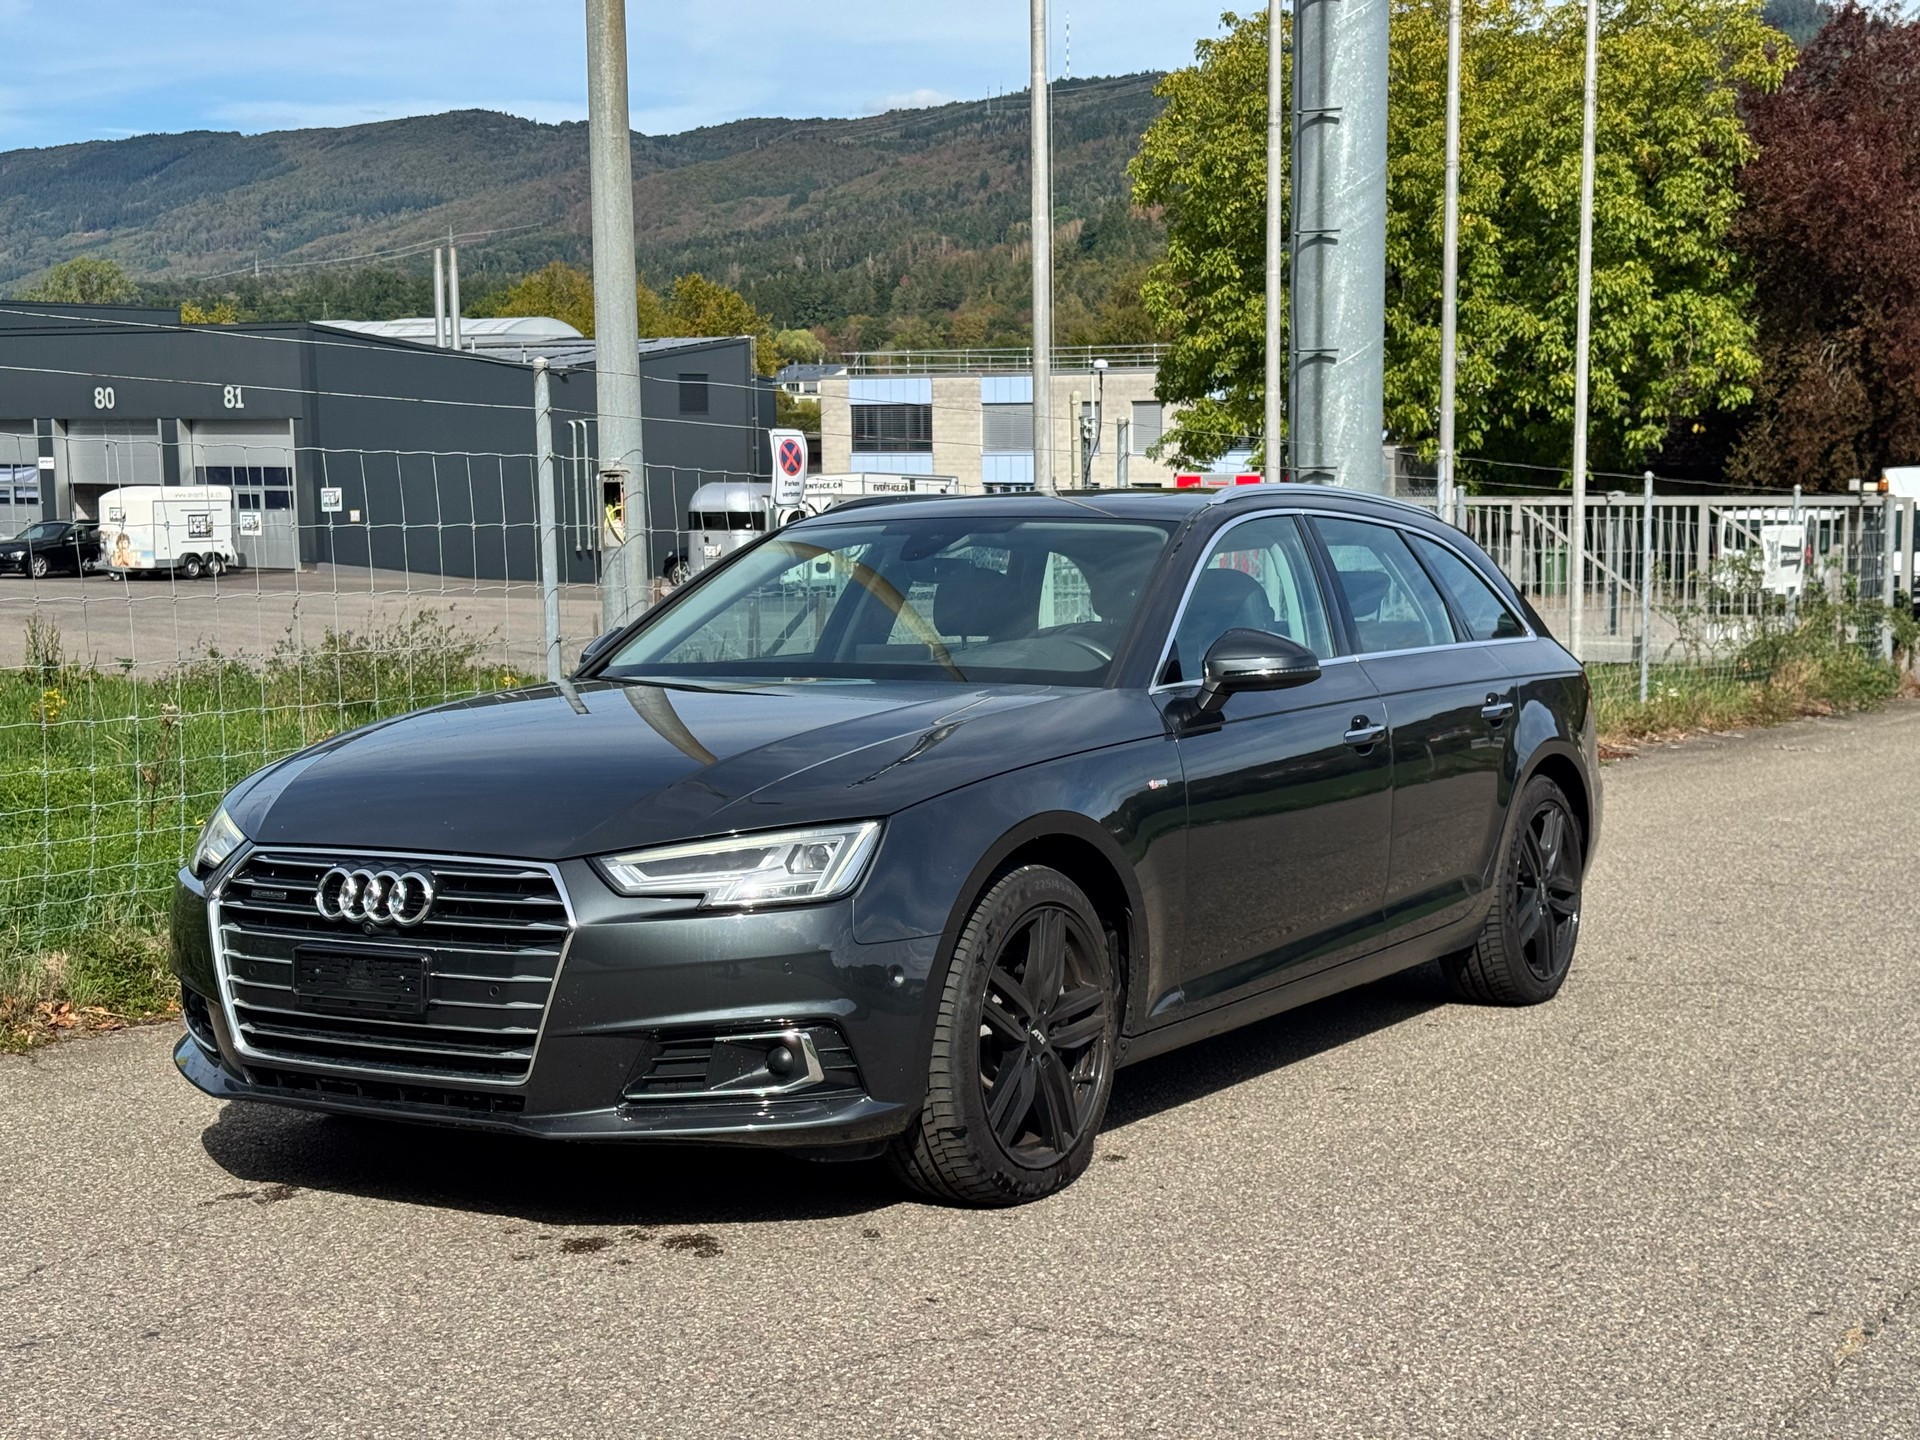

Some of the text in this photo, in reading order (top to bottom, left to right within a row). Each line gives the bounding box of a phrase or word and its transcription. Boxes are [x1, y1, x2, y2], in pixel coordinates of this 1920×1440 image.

[94, 387, 115, 409] 80
[224, 386, 245, 409] 81
[805, 482, 842, 490] ENT-ICE.CH
